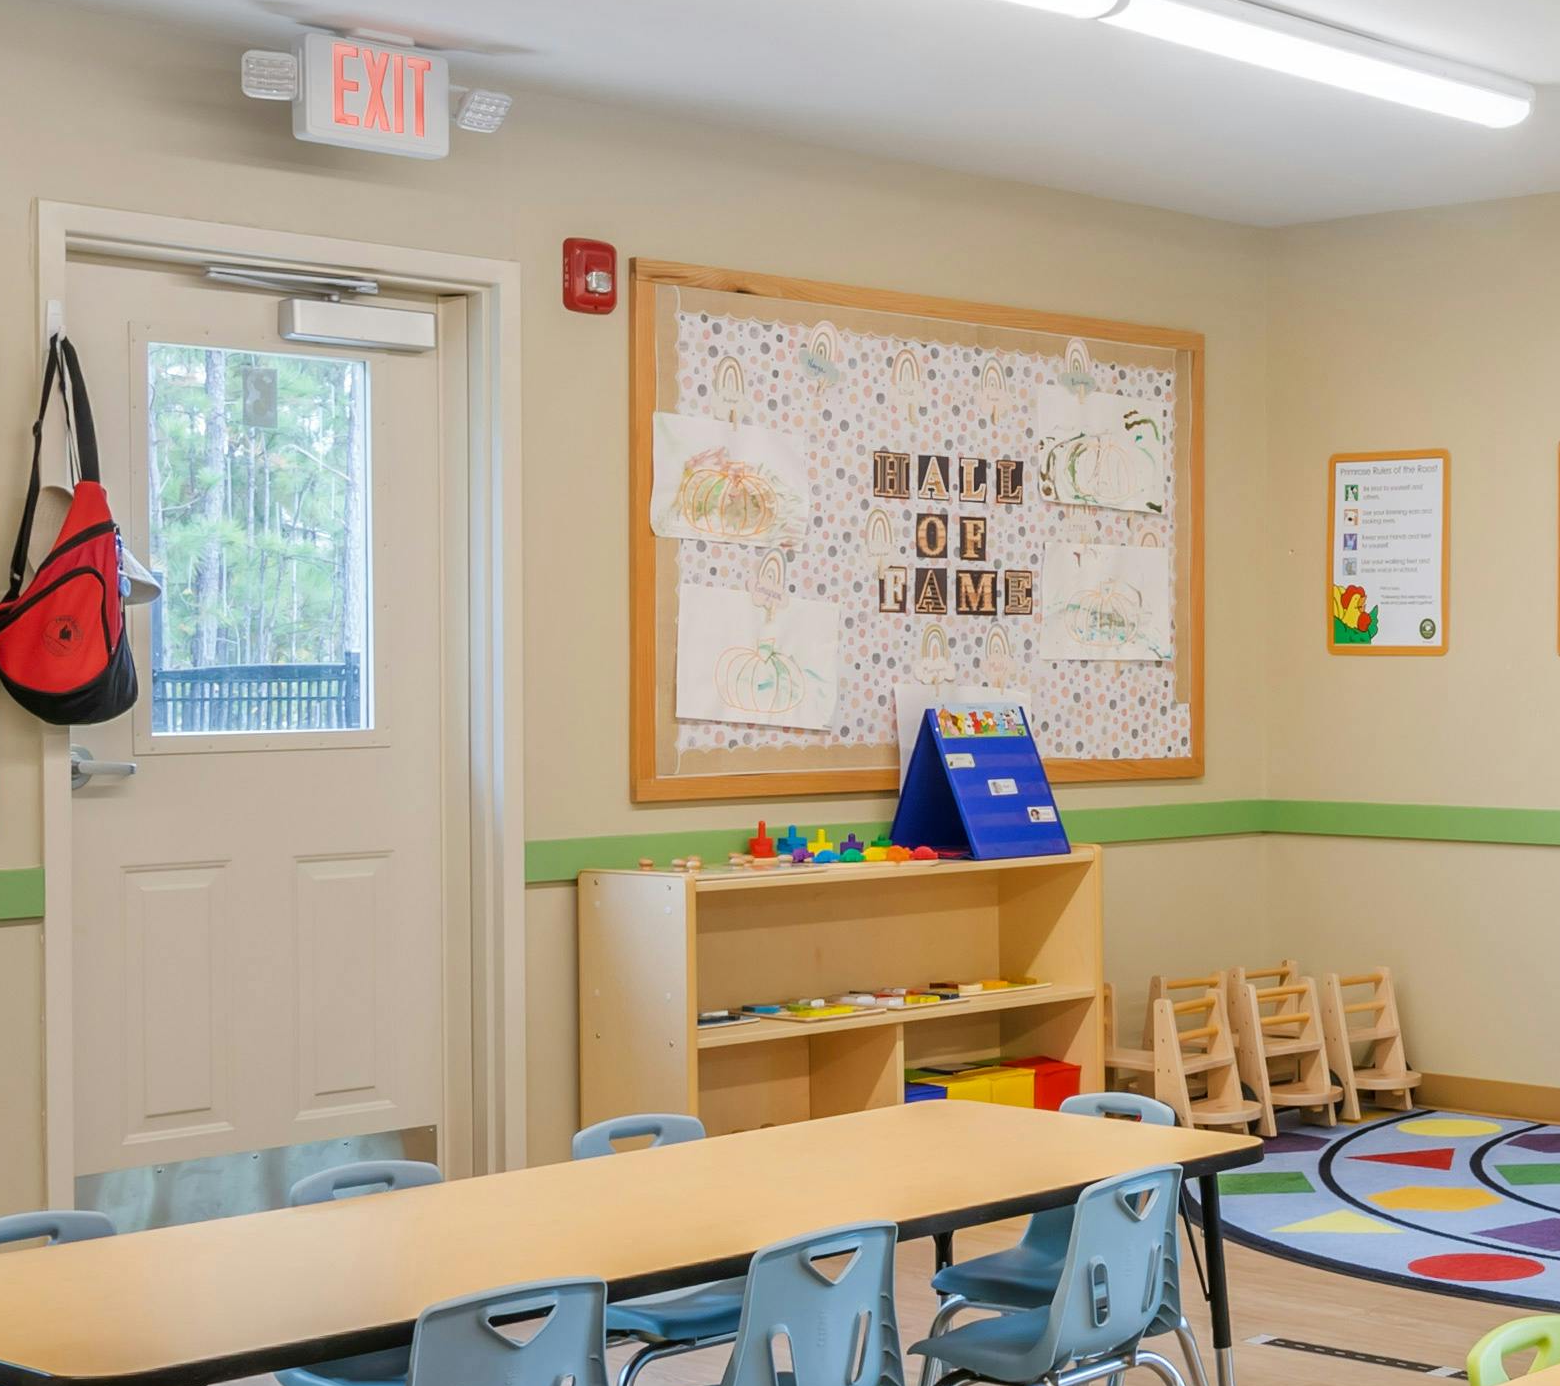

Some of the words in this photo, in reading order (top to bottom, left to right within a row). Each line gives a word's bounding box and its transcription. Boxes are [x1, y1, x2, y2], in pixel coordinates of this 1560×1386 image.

[332, 43, 431, 138] EXIT
[874, 452, 1023, 504] HALL
[918, 516, 986, 558] OF
[880, 567, 1032, 614] FAME
